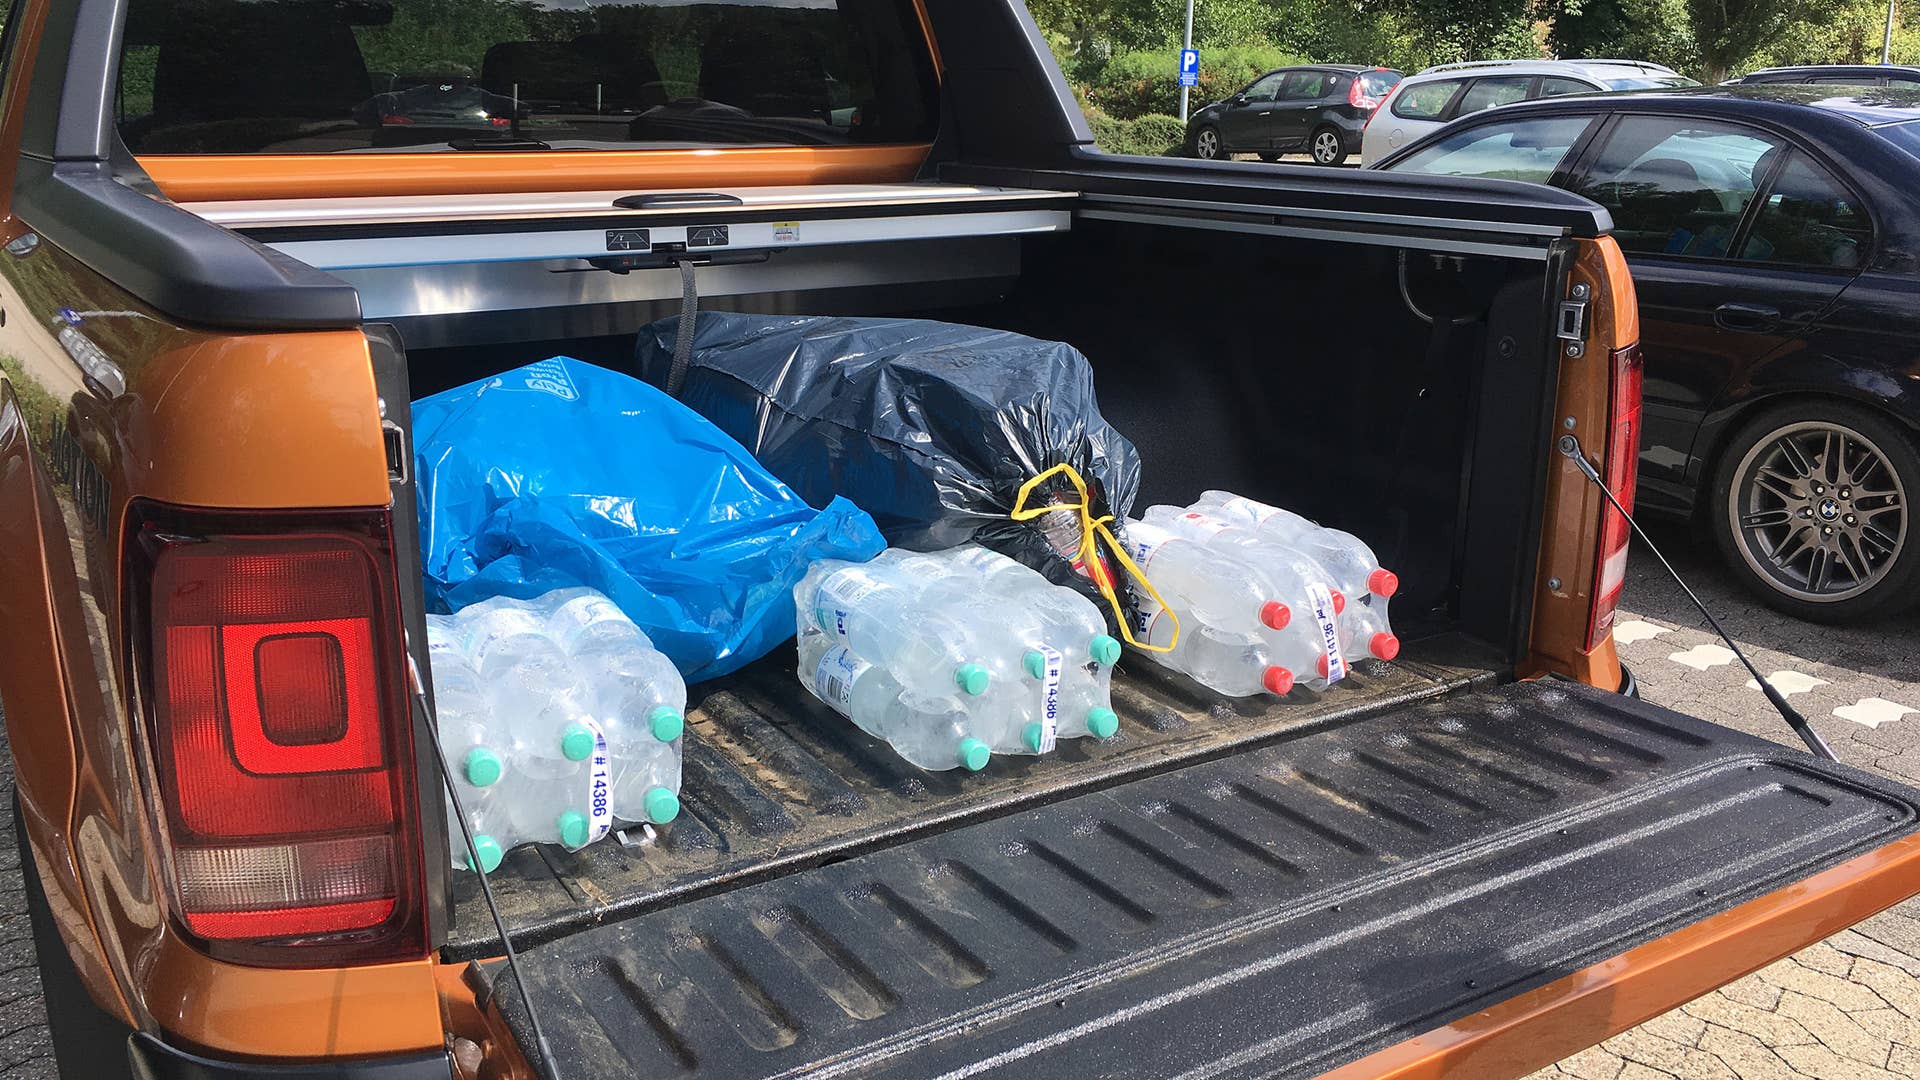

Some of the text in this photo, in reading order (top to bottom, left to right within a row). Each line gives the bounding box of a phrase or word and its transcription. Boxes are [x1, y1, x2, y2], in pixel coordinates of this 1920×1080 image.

[1183, 51, 1197, 72] P
[1322, 623, 1337, 657] 14136
[1049, 669, 1058, 677] #
[1046, 682, 1058, 719] 14386
[594, 756, 606, 765] #
[592, 771, 607, 817] 14386
